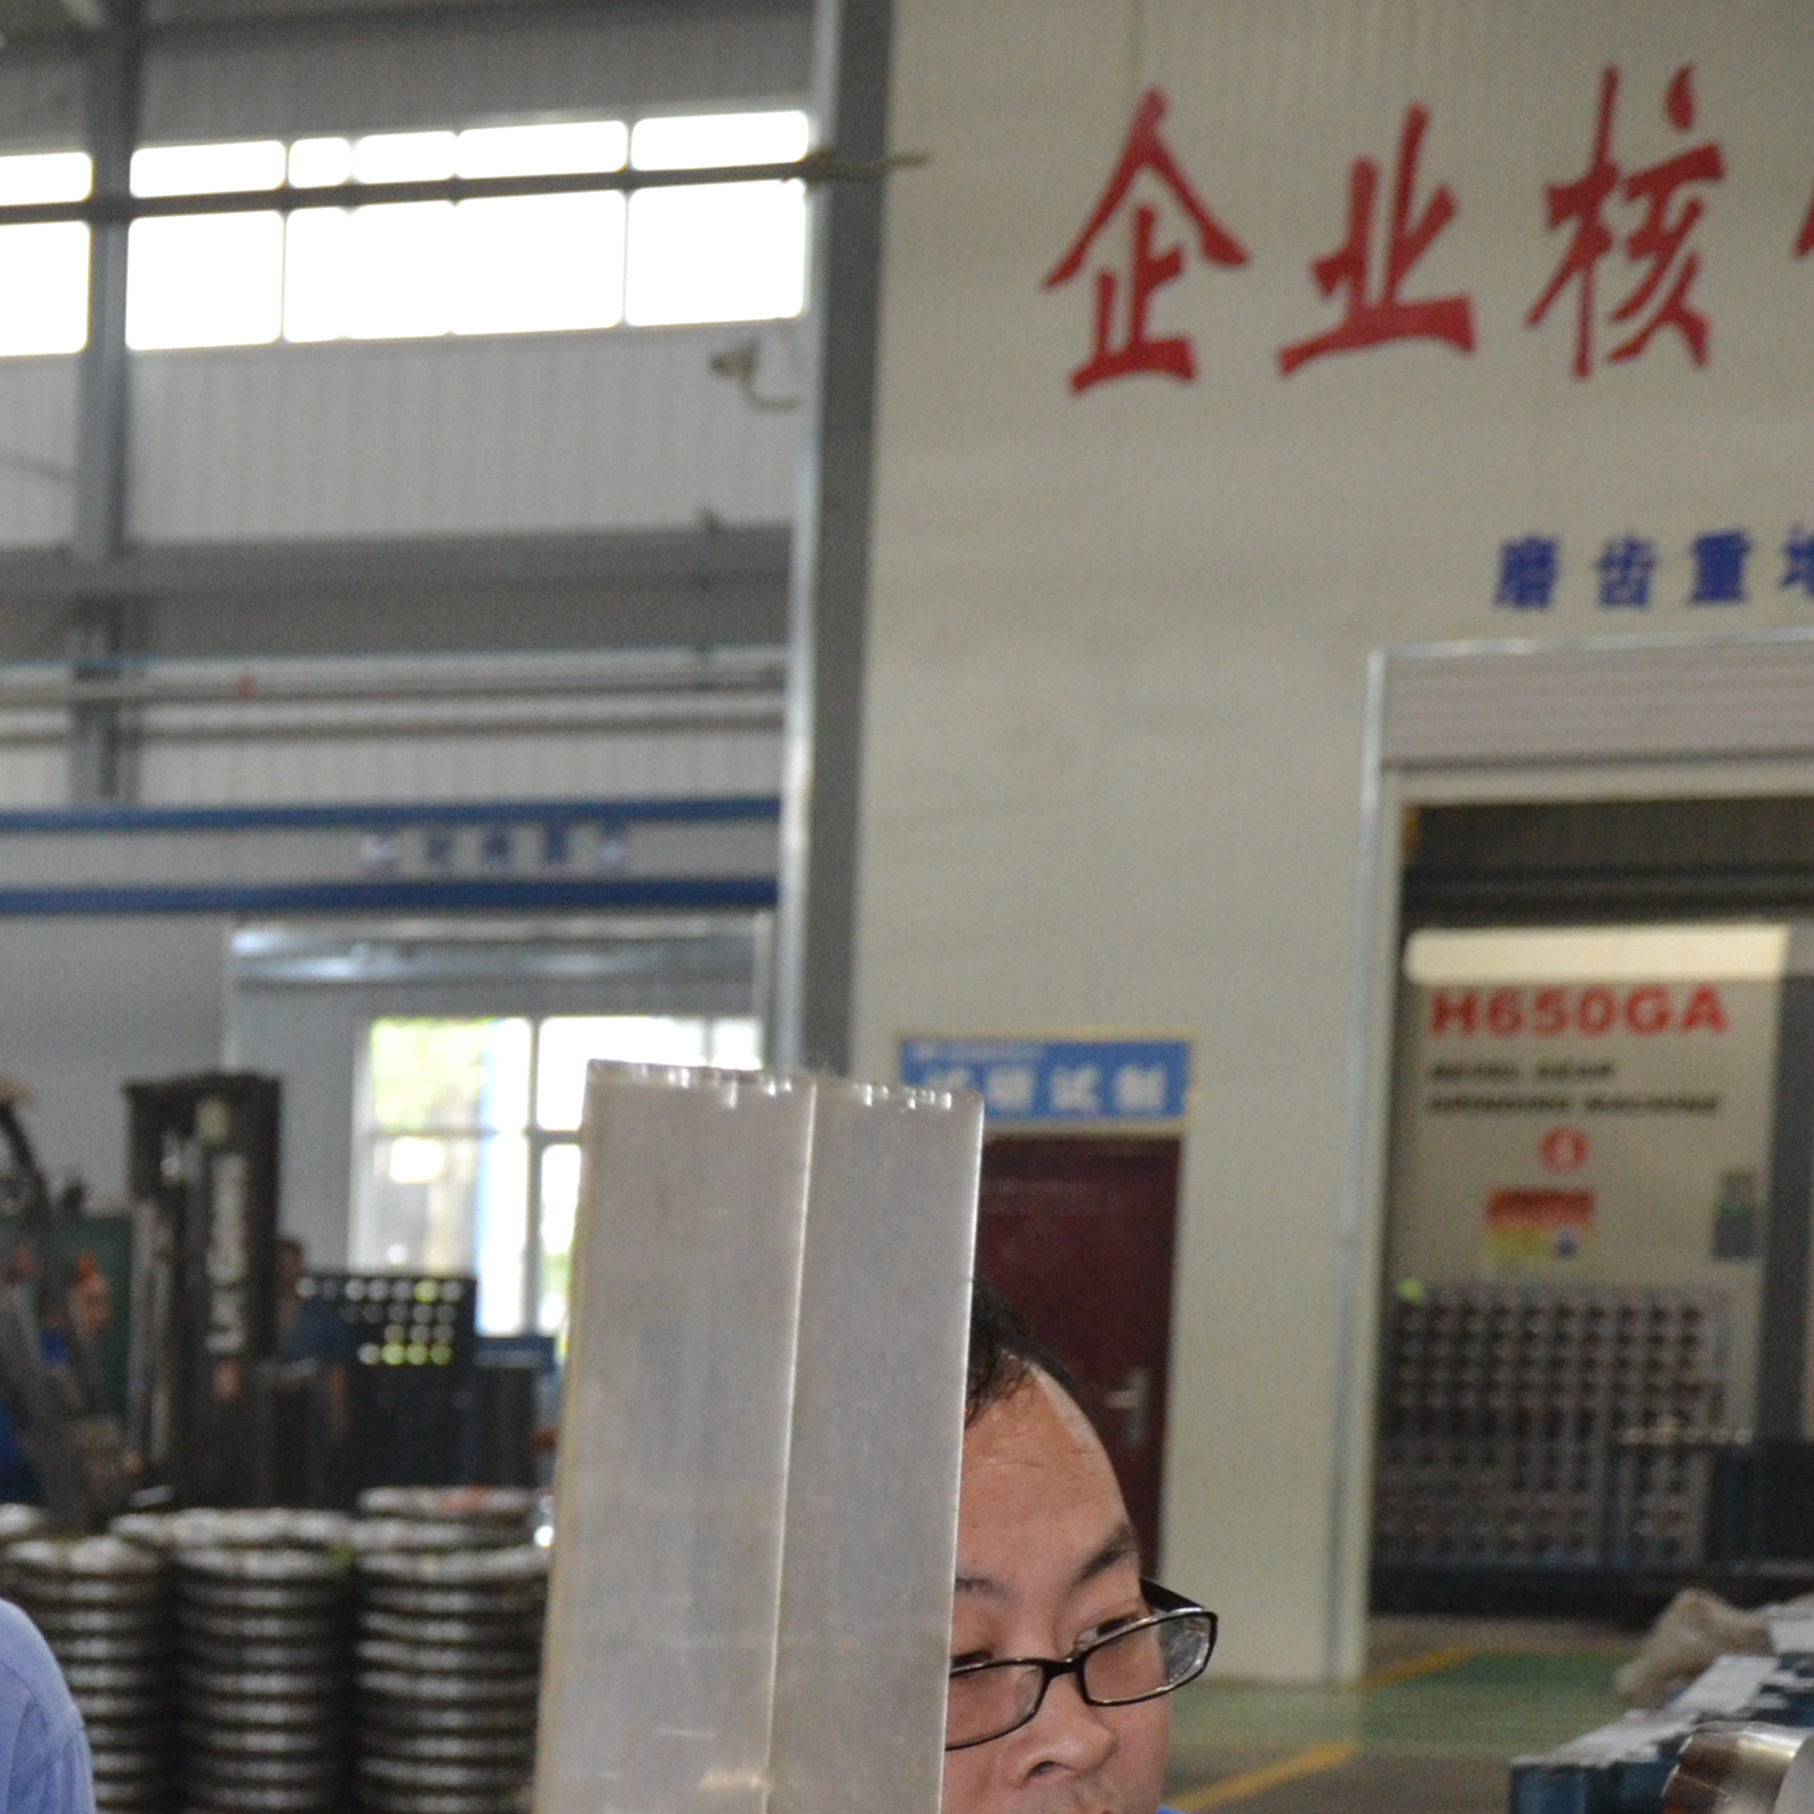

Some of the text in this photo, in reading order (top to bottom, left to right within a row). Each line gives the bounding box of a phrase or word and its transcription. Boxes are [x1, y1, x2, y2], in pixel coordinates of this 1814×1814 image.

[1041, 62, 1814, 398] 企业核
[1429, 985, 1727, 1037] H650GA
